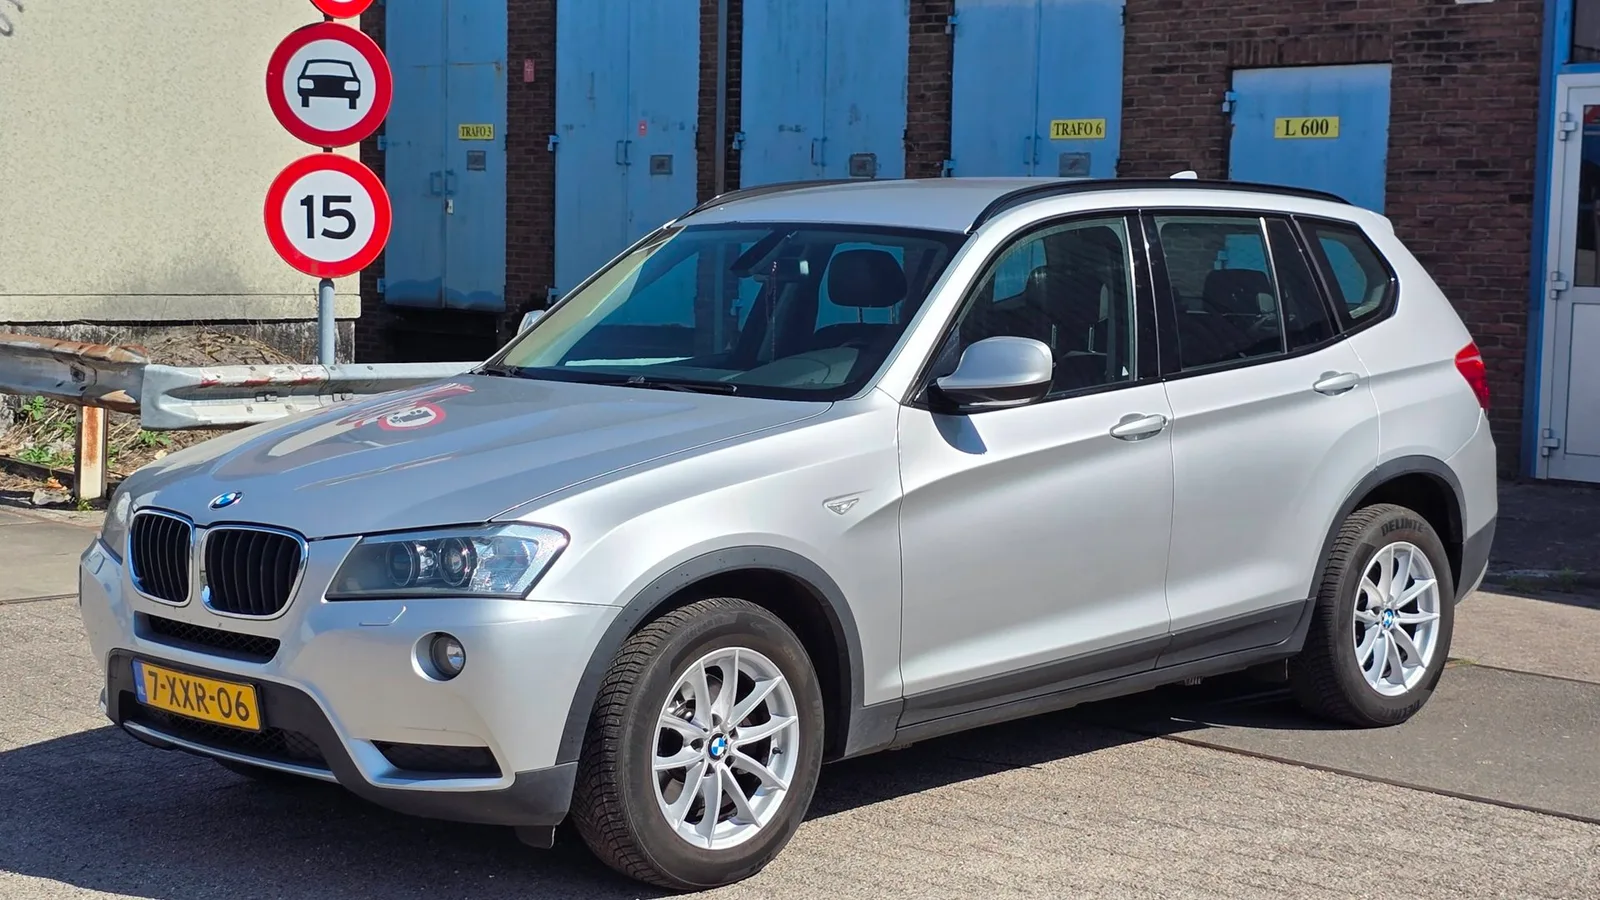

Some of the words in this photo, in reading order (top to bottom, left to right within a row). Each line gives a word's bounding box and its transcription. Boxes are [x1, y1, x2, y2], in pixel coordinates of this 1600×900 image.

[461, 126, 486, 137] TRAFO
[487, 126, 492, 137] 3
[1053, 122, 1093, 136] TRAFO
[1095, 122, 1102, 136] 6
[1284, 119, 1296, 136] L
[1301, 118, 1329, 136] 600
[300, 195, 356, 240] 15
[1381, 518, 1425, 537] DELINTE
[148, 670, 250, 722] 7-XXR-06
